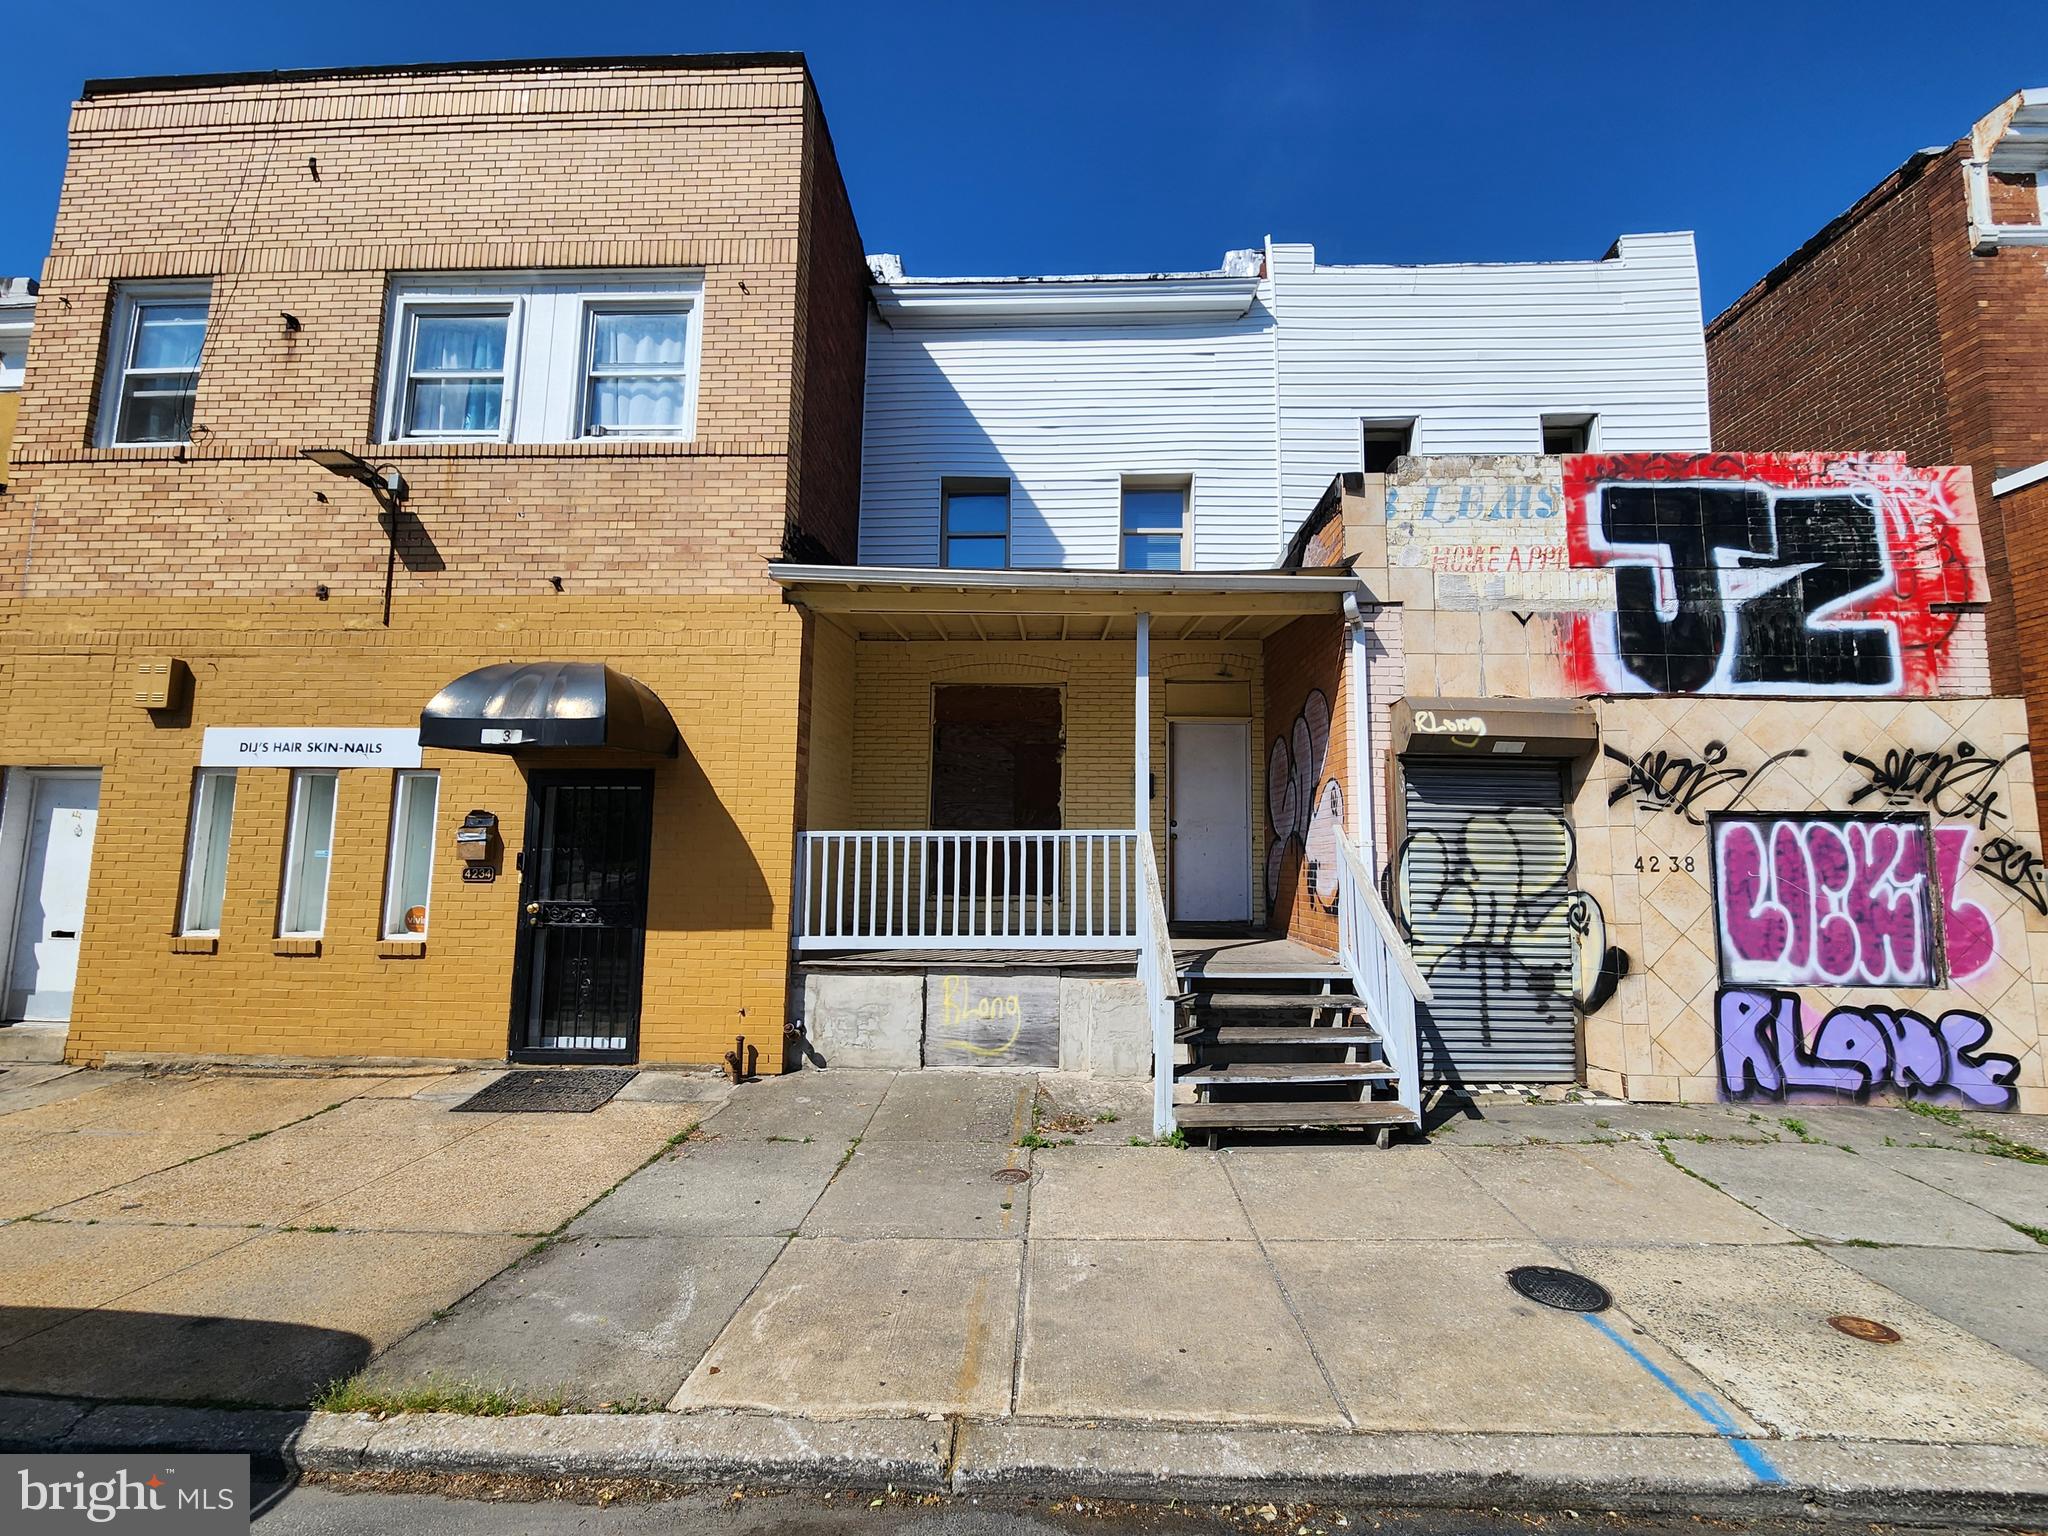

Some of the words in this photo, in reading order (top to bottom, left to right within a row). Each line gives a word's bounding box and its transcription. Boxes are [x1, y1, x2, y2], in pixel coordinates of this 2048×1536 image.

[502, 730, 512, 742] 3
[273, 742, 302, 753] HAIR
[306, 742, 383, 754] SKIN-NAILS
[1633, 855, 1696, 873] 4238
[464, 868, 492, 879] 4234
